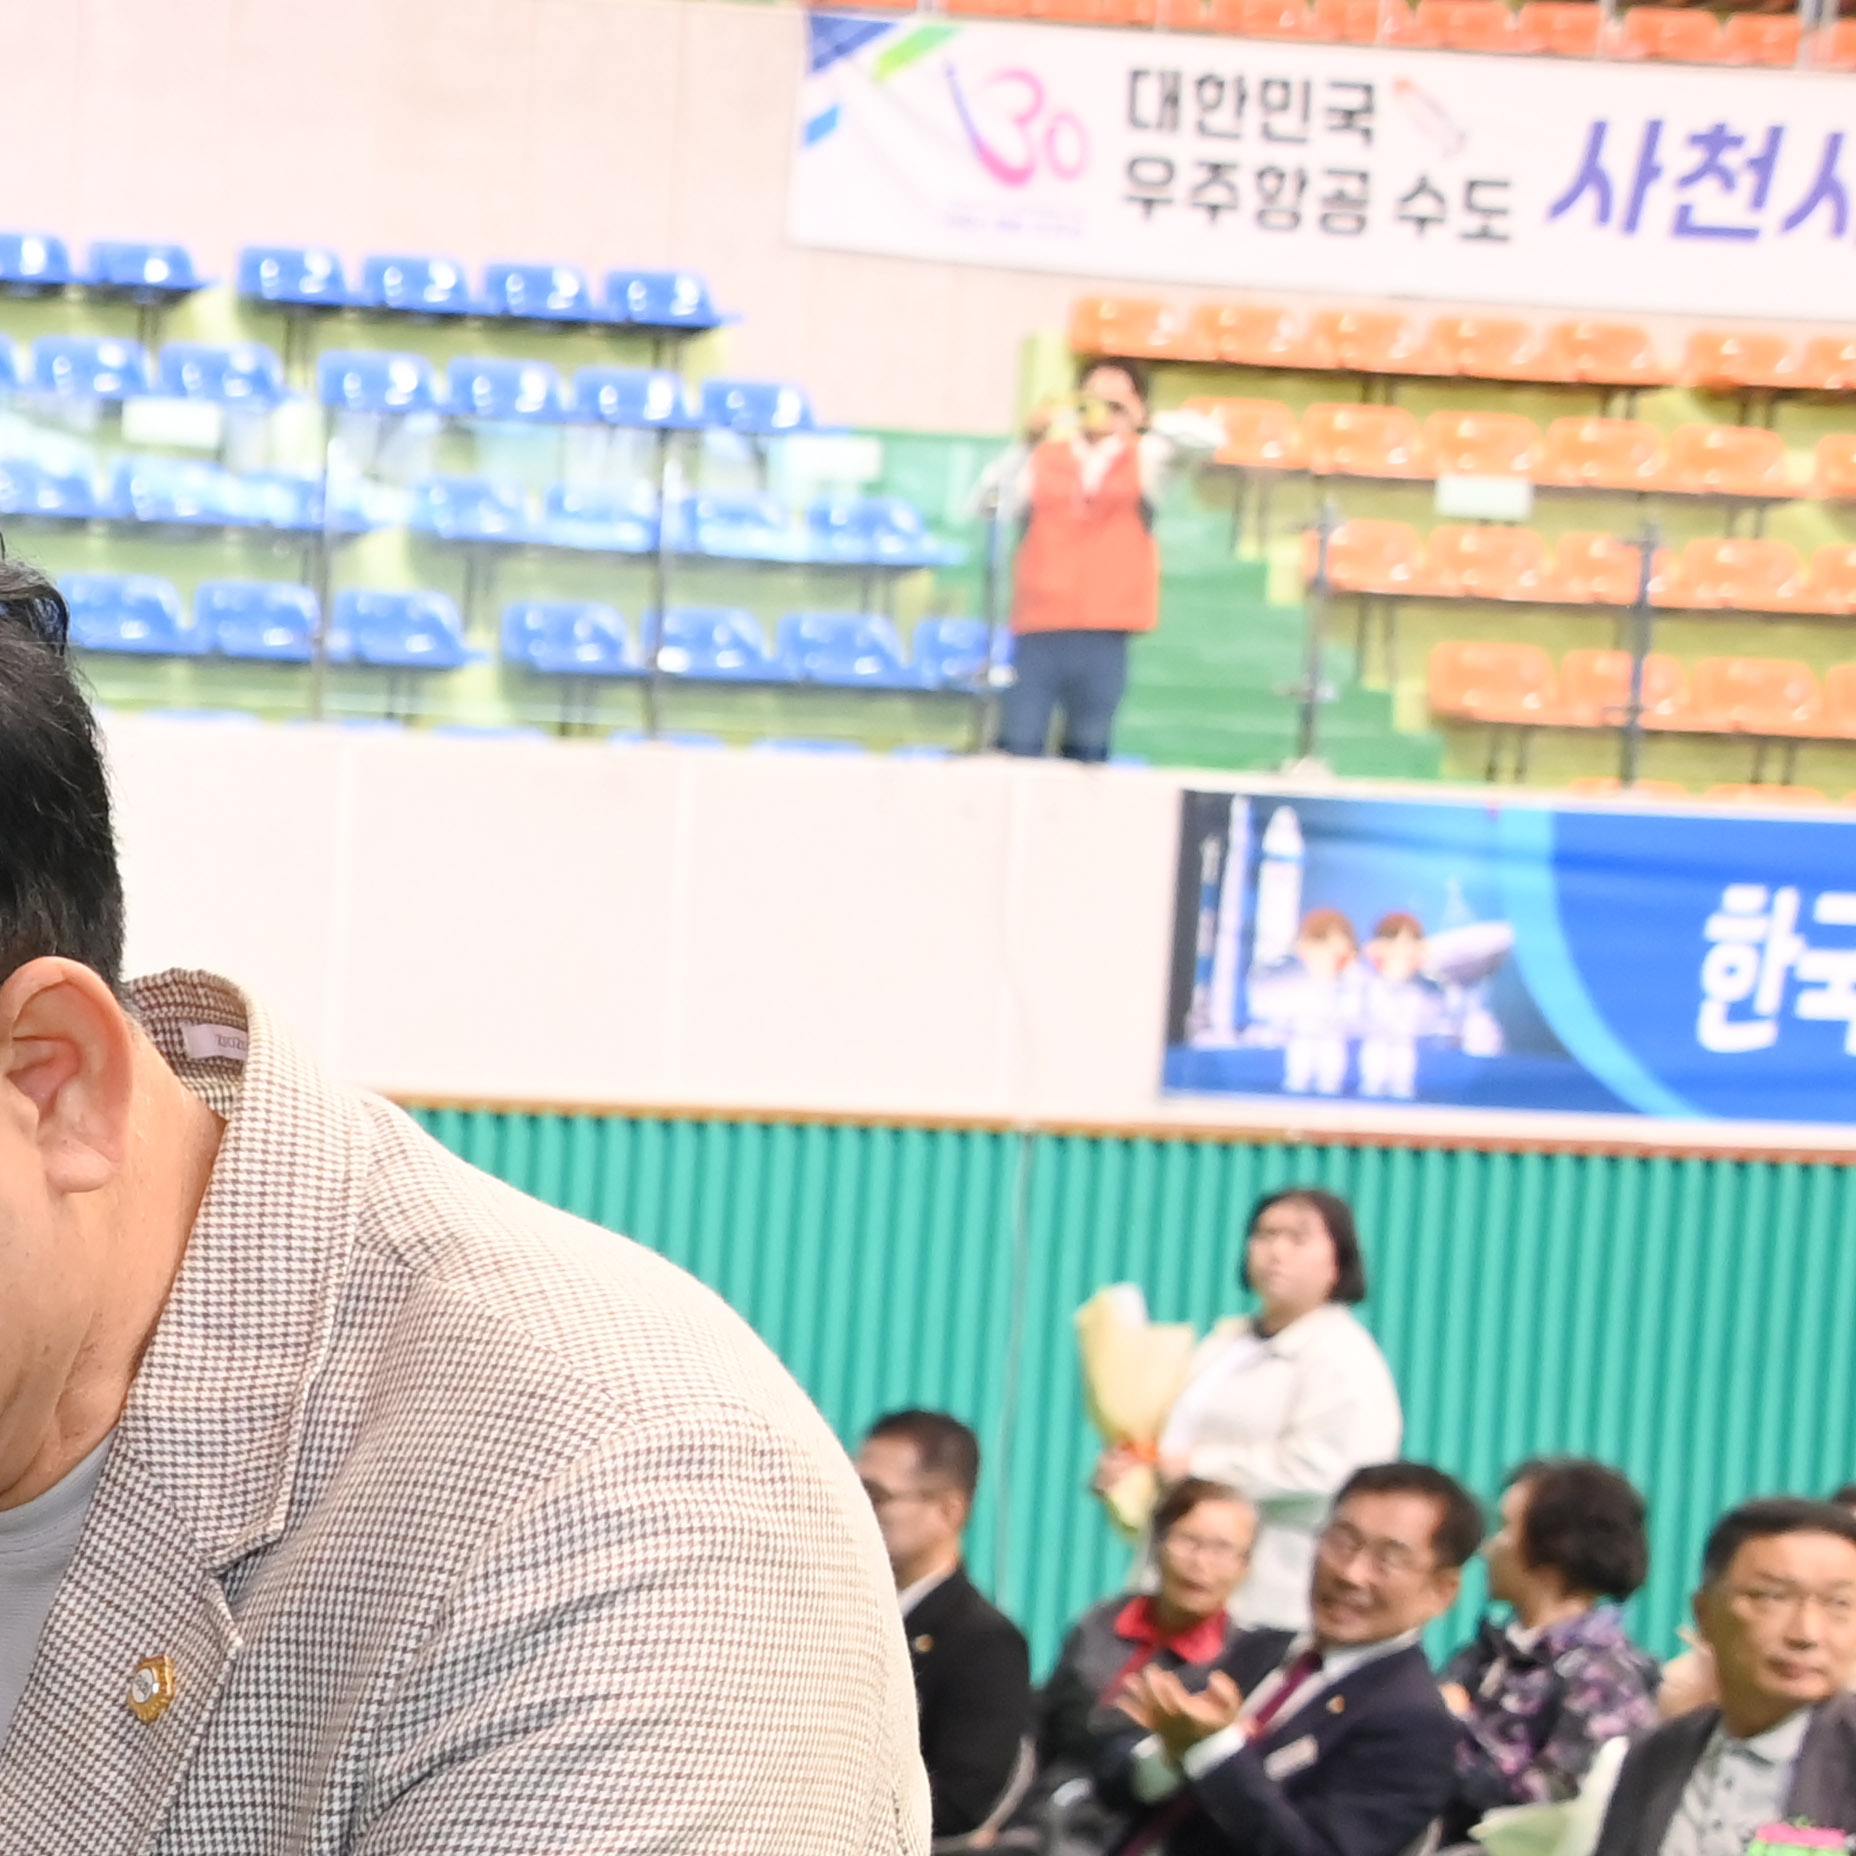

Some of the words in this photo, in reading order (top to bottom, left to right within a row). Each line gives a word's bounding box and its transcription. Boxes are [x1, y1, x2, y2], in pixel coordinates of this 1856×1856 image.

[1126, 66, 1376, 146] 대한민국
[1124, 155, 1371, 234] 우주항공
[1396, 174, 1514, 243] 수도
